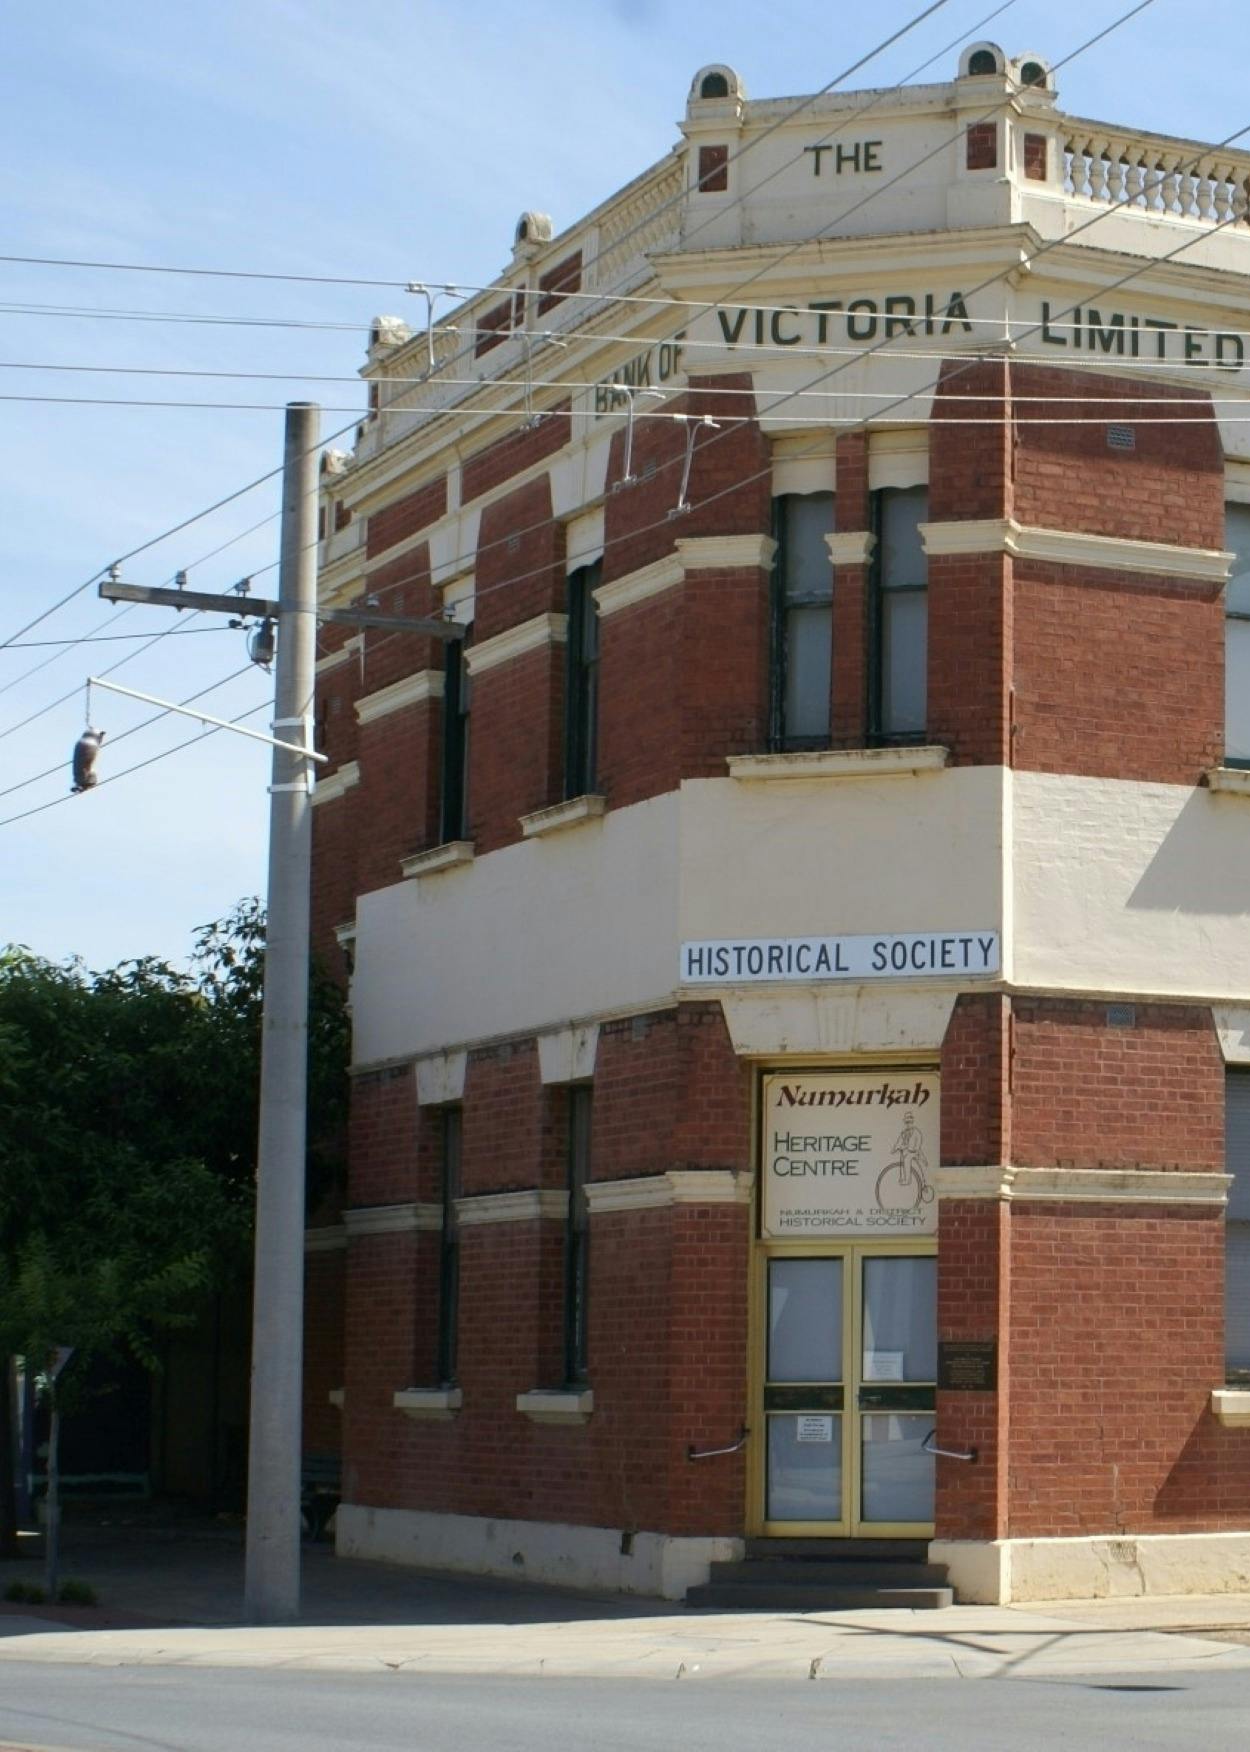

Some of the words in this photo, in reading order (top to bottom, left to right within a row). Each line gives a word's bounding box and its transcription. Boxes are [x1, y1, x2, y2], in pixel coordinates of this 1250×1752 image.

[803, 140, 882, 177] THE
[718, 291, 972, 350] VICTORIA
[1041, 301, 1244, 373] LIMITED
[595, 348, 651, 420] BANK
[659, 330, 686, 381] OF
[687, 943, 849, 976] HISTORICAL
[871, 937, 994, 971] SOCIETY
[776, 1082, 930, 1109] Numurkah
[774, 1131, 872, 1152] HERITAGE
[773, 1157, 859, 1177] CENTRE
[779, 1208, 849, 1216] NUMURKAH
[779, 1217, 862, 1227] HISTORICAL
[866, 1216, 926, 1227] SOCIETY
